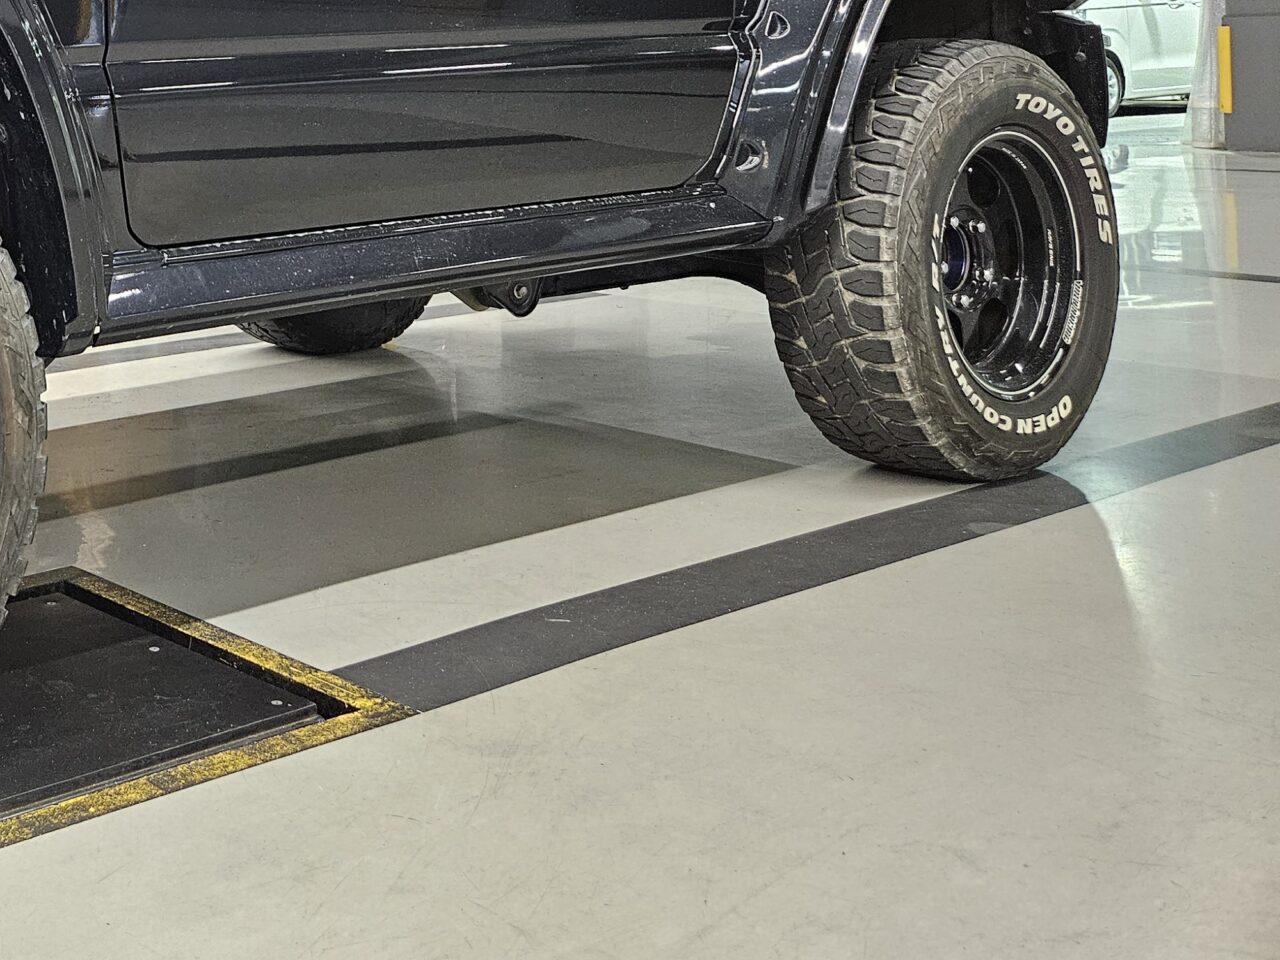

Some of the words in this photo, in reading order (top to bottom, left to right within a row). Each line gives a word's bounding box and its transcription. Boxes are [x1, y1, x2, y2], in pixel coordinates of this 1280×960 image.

[1015, 93, 1075, 136] TOYO
[1071, 135, 1113, 246] TIRES
[934, 304, 1013, 432] COUNTRY
[1017, 394, 1072, 434] OPEN
